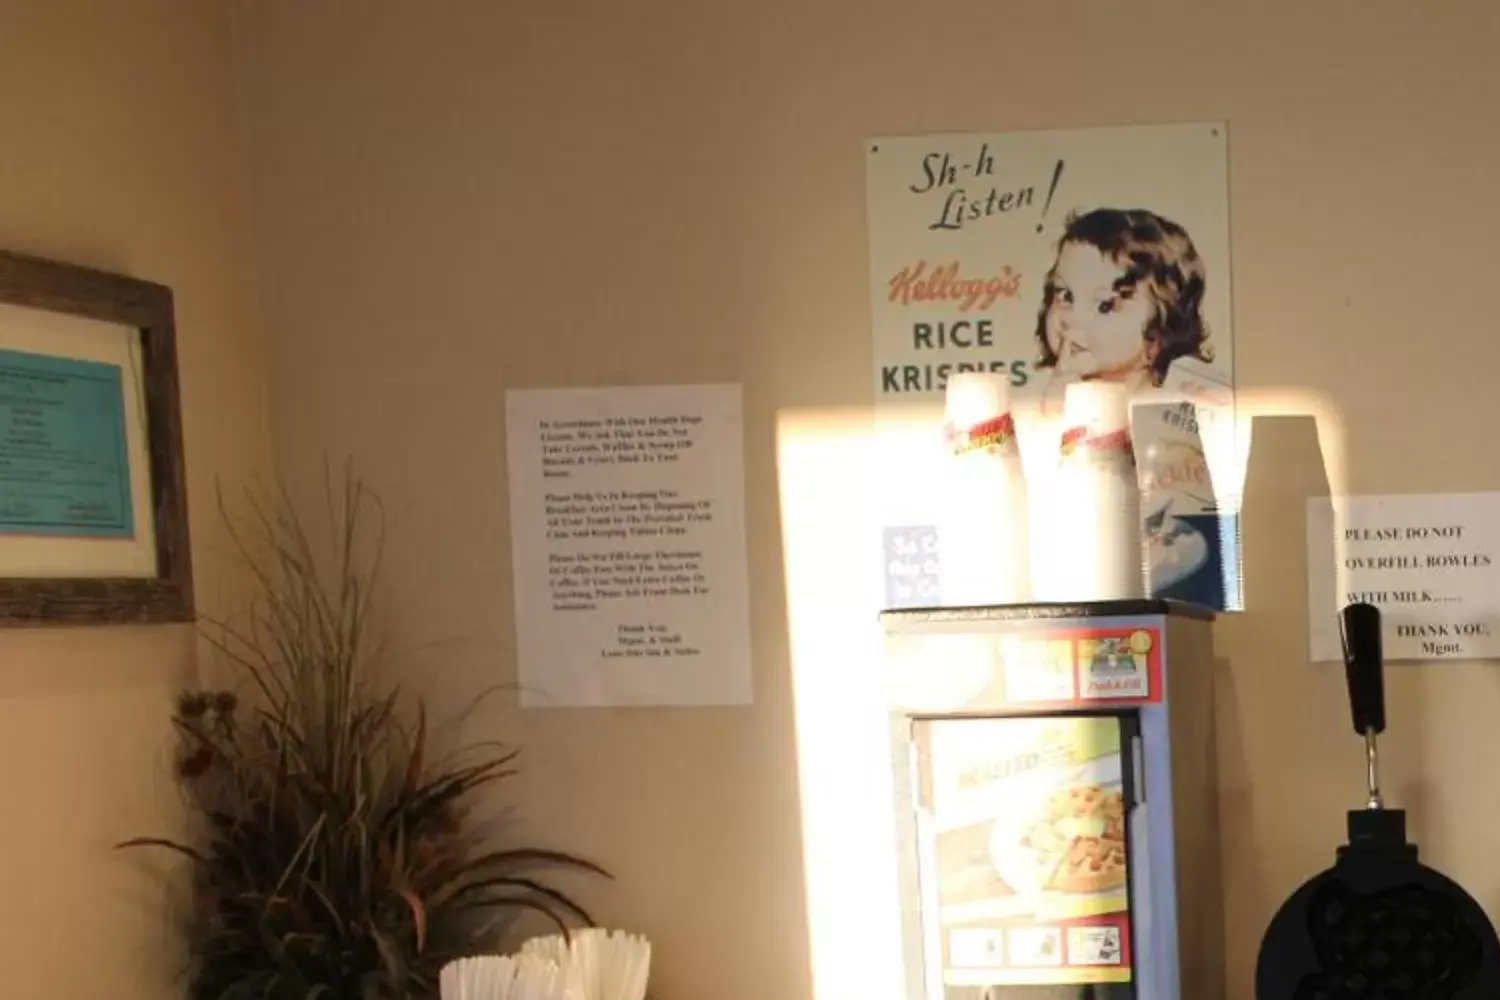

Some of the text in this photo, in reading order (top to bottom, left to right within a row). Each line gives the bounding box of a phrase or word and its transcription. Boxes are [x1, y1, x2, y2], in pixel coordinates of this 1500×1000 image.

[911, 143, 994, 193] Sh-h
[888, 259, 1021, 312] Kellogg's
[913, 320, 995, 350] RICE
[1345, 525, 1464, 541] PLEASE DO NOT
[1345, 553, 1492, 570] OVERFILL BOWLES
[1346, 591, 1388, 603] WITH
[1396, 624, 1449, 638] THANK
[1421, 641, 1464, 656] Mgmt.
